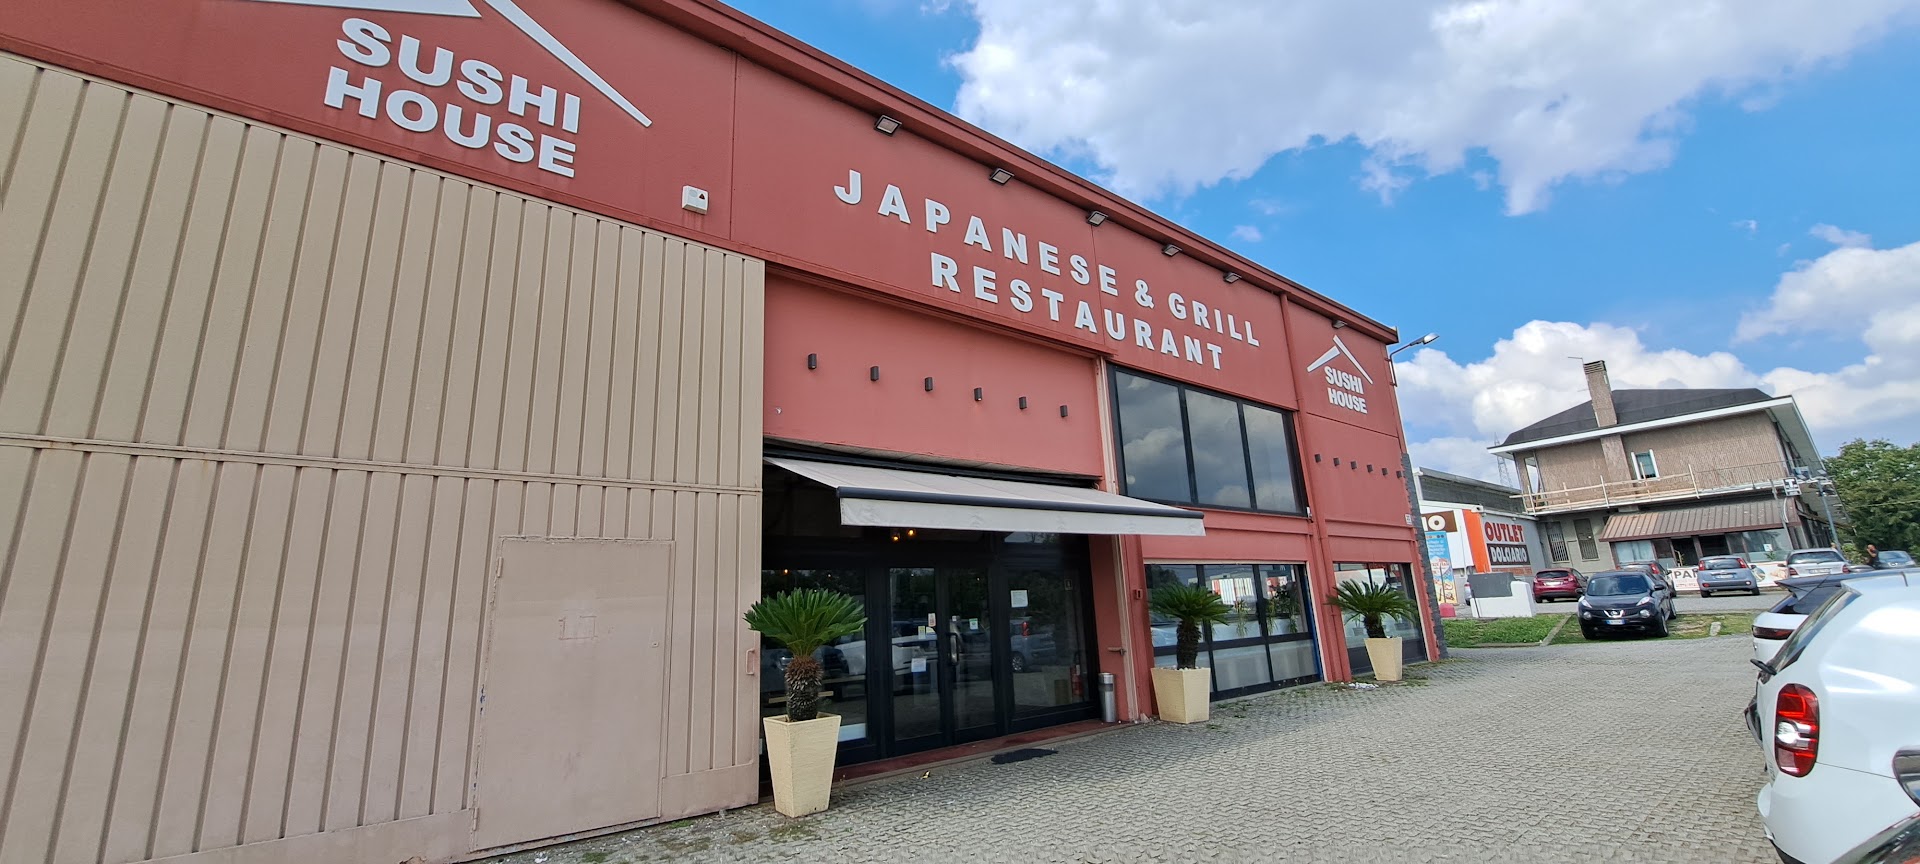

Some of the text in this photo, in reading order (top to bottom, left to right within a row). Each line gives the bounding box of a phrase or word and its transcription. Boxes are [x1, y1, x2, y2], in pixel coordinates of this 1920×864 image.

[336, 17, 581, 134] SUSHI
[323, 65, 576, 178] HOUSE
[833, 169, 1260, 348] JAPANESE & GRILL
[930, 251, 1223, 371] RESTAURANT
[1324, 365, 1364, 395] SUSHI
[1327, 387, 1368, 415] HOUSE
[1484, 521, 1524, 543] OUTLET
[1490, 546, 1528, 563] DOLCIARIO
